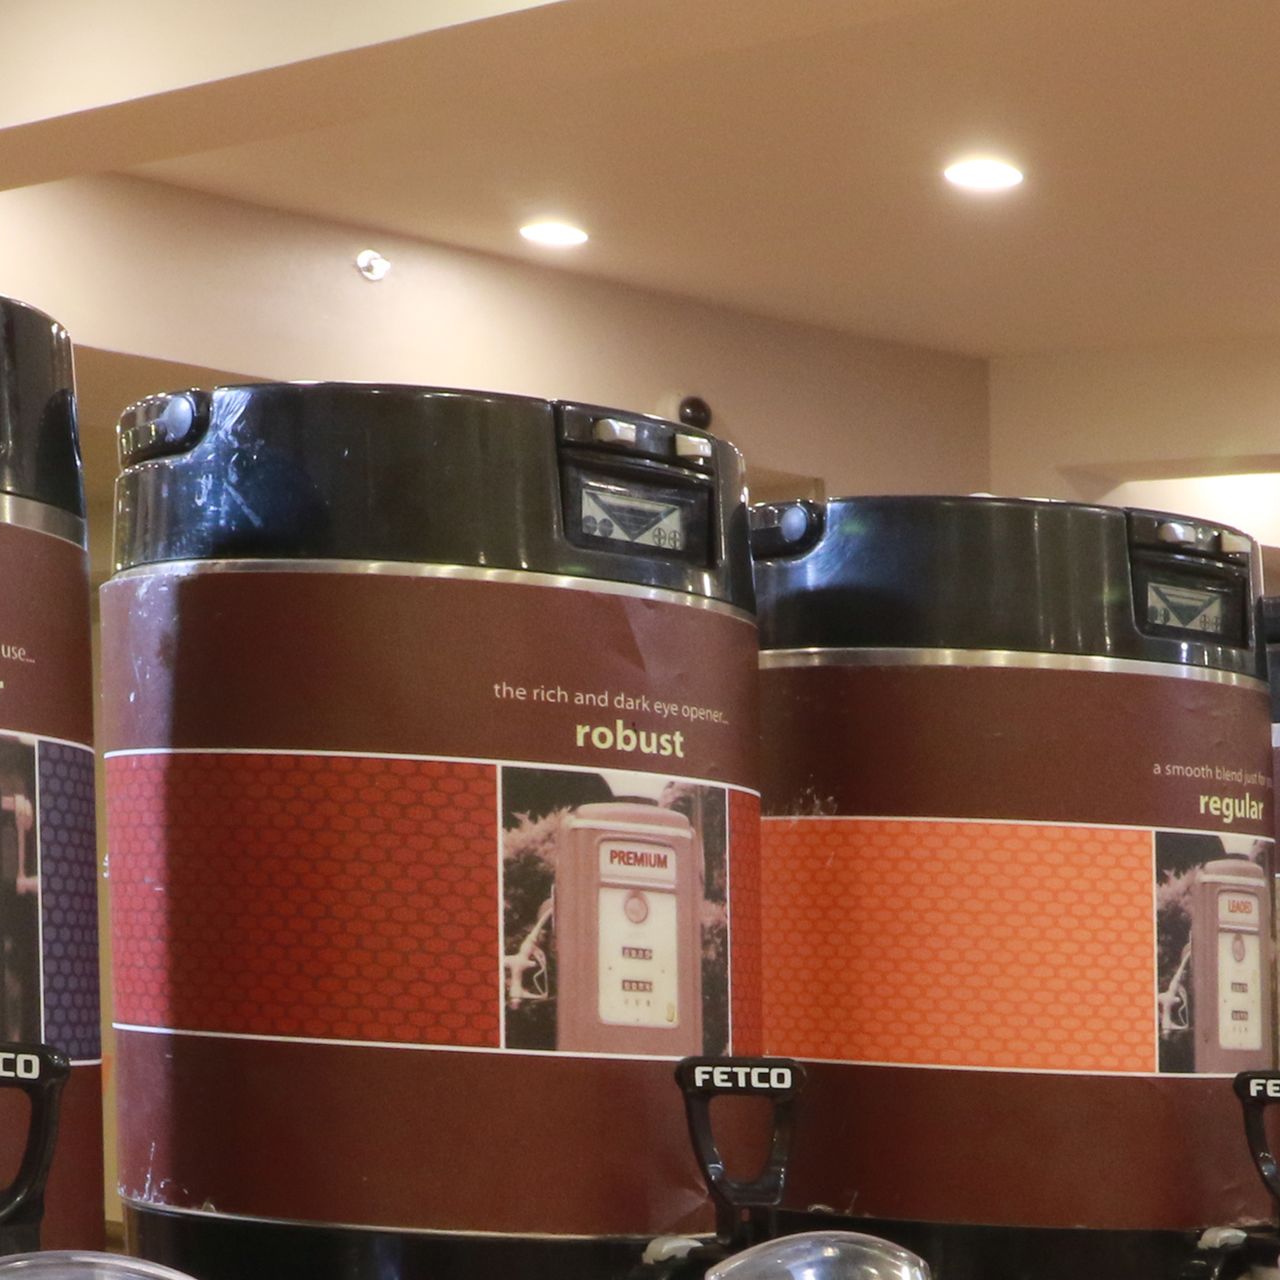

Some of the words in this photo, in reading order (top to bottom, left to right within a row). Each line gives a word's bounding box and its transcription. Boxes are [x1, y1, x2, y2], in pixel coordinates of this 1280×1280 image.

[494, 681, 527, 700] the
[533, 685, 568, 703] rich
[574, 690, 608, 707] and
[613, 692, 651, 713] dark
[653, 700, 679, 718] eye
[575, 719, 685, 759] robust
[1153, 763, 1161, 775] a
[1165, 764, 1213, 779] smooth
[1215, 765, 1243, 783] blend
[1199, 792, 1264, 823] regular
[610, 849, 668, 869] PREMIUM
[694, 1065, 793, 1089] FETCO
